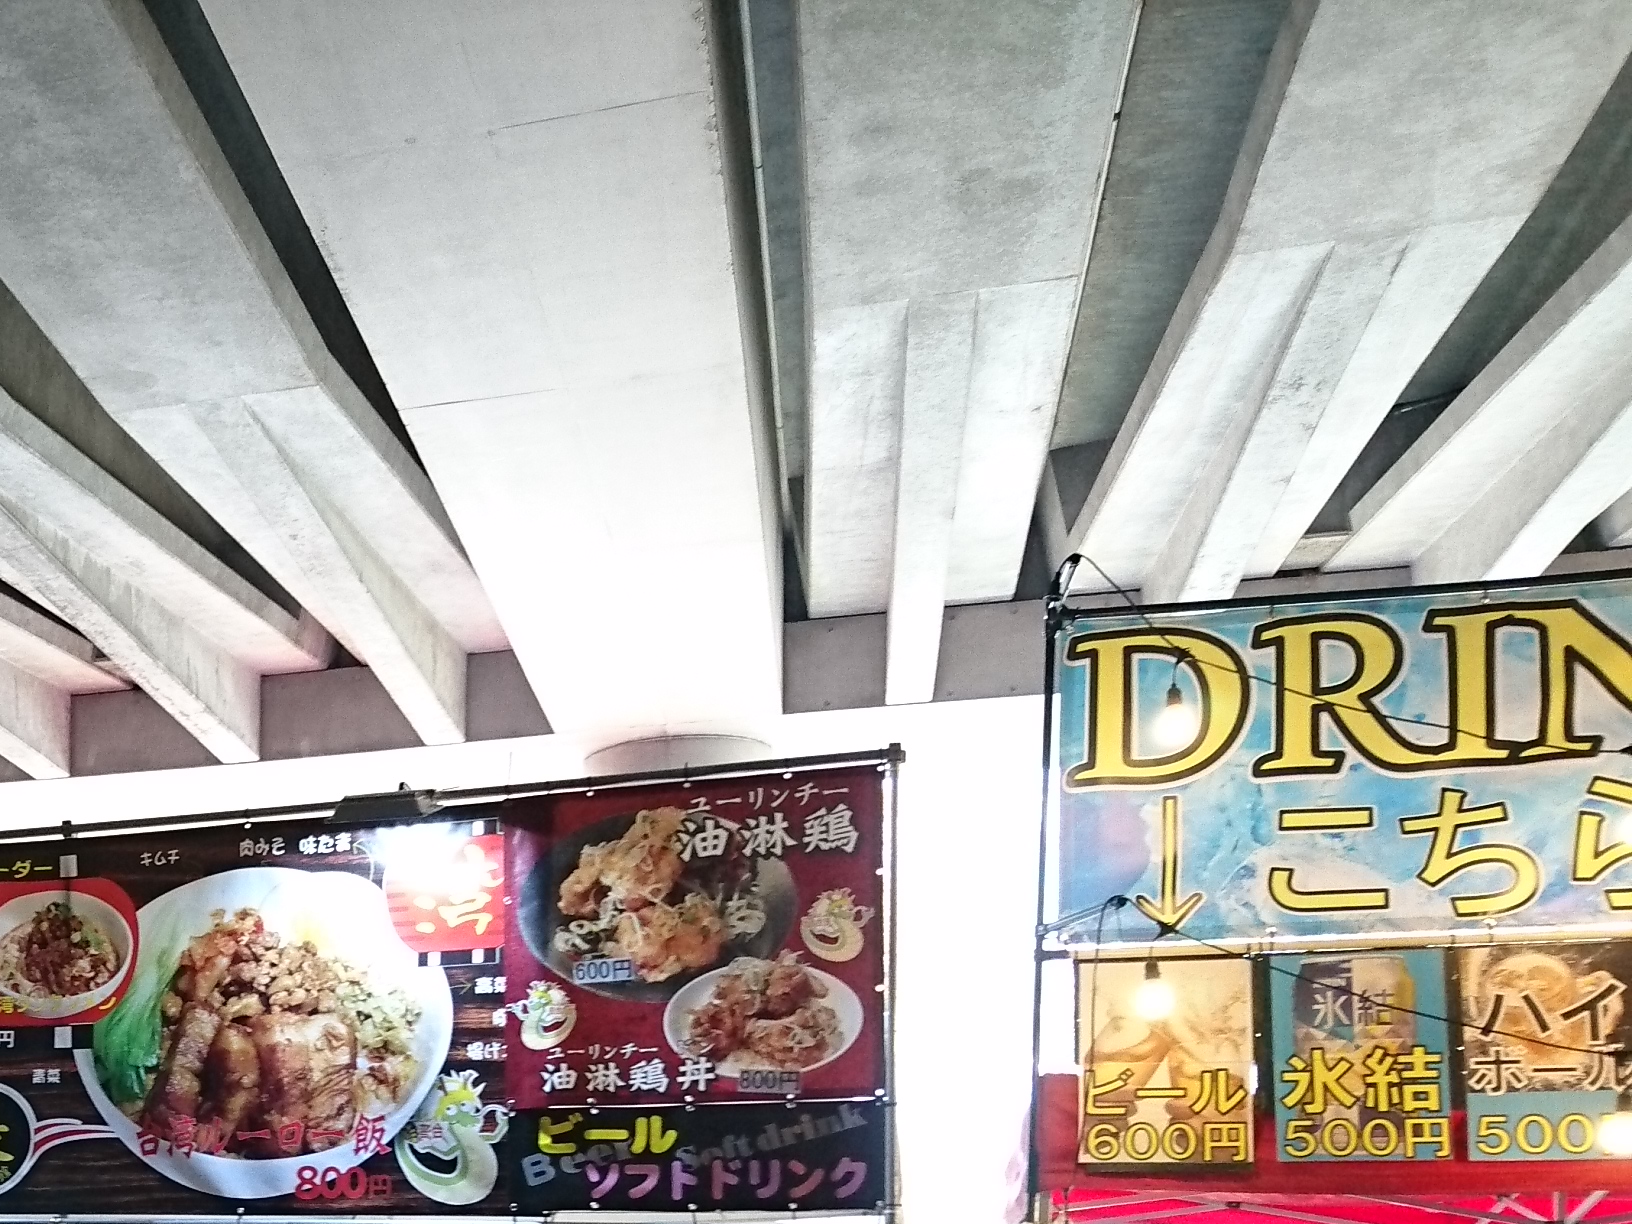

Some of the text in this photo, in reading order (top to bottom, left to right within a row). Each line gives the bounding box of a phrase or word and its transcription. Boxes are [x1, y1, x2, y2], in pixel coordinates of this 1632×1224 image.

[685, 782, 850, 815] ユーリンチー
[239, 837, 286, 857] 肉みそ
[677, 802, 860, 863] 油淋鶏
[139, 850, 181, 867] キムチ
[575, 958, 632, 982] 600円
[546, 1042, 658, 1060] ユーリンチー
[540, 1058, 716, 1093] 油淋鶏丼
[739, 1070, 800, 1092] 800円
[1084, 1067, 1246, 1119] ビール
[1281, 1046, 1444, 1114] 氷結
[538, 1112, 678, 1154] ビール
[756, 1103, 868, 1152] drink
[1084, 1122, 1249, 1164] 600円
[1284, 1116, 1452, 1158] 500円
[1476, 1113, 1626, 1156] 500
[294, 1164, 392, 1200] 800円
[586, 1157, 868, 1200] ソフトドリンク
